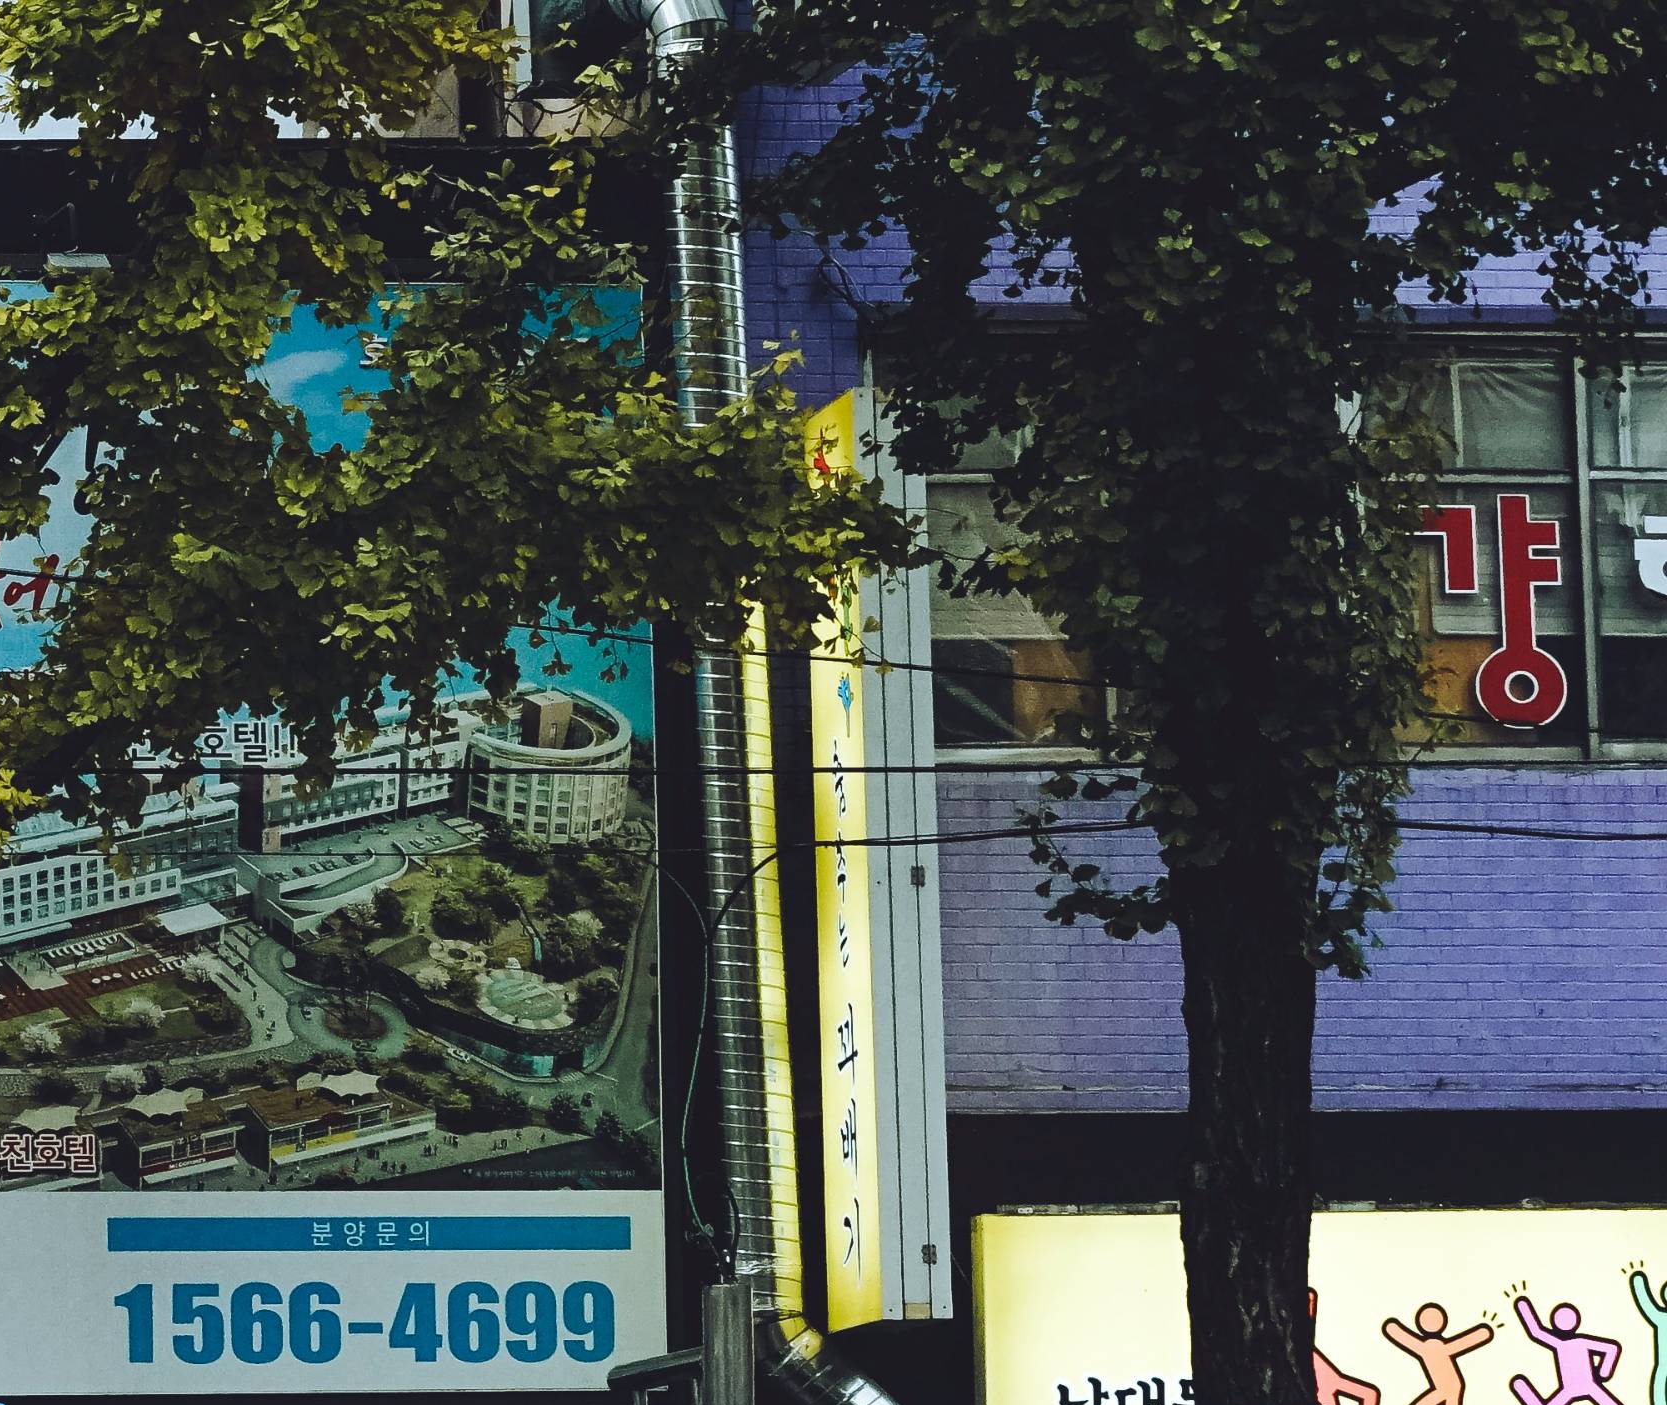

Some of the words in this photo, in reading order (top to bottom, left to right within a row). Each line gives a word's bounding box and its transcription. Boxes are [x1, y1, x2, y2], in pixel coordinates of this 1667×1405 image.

[836, 1002, 862, 1282] 꽈배기
[310, 1220, 432, 1248] 분양문의
[113, 1280, 616, 1365] 1566-4699
